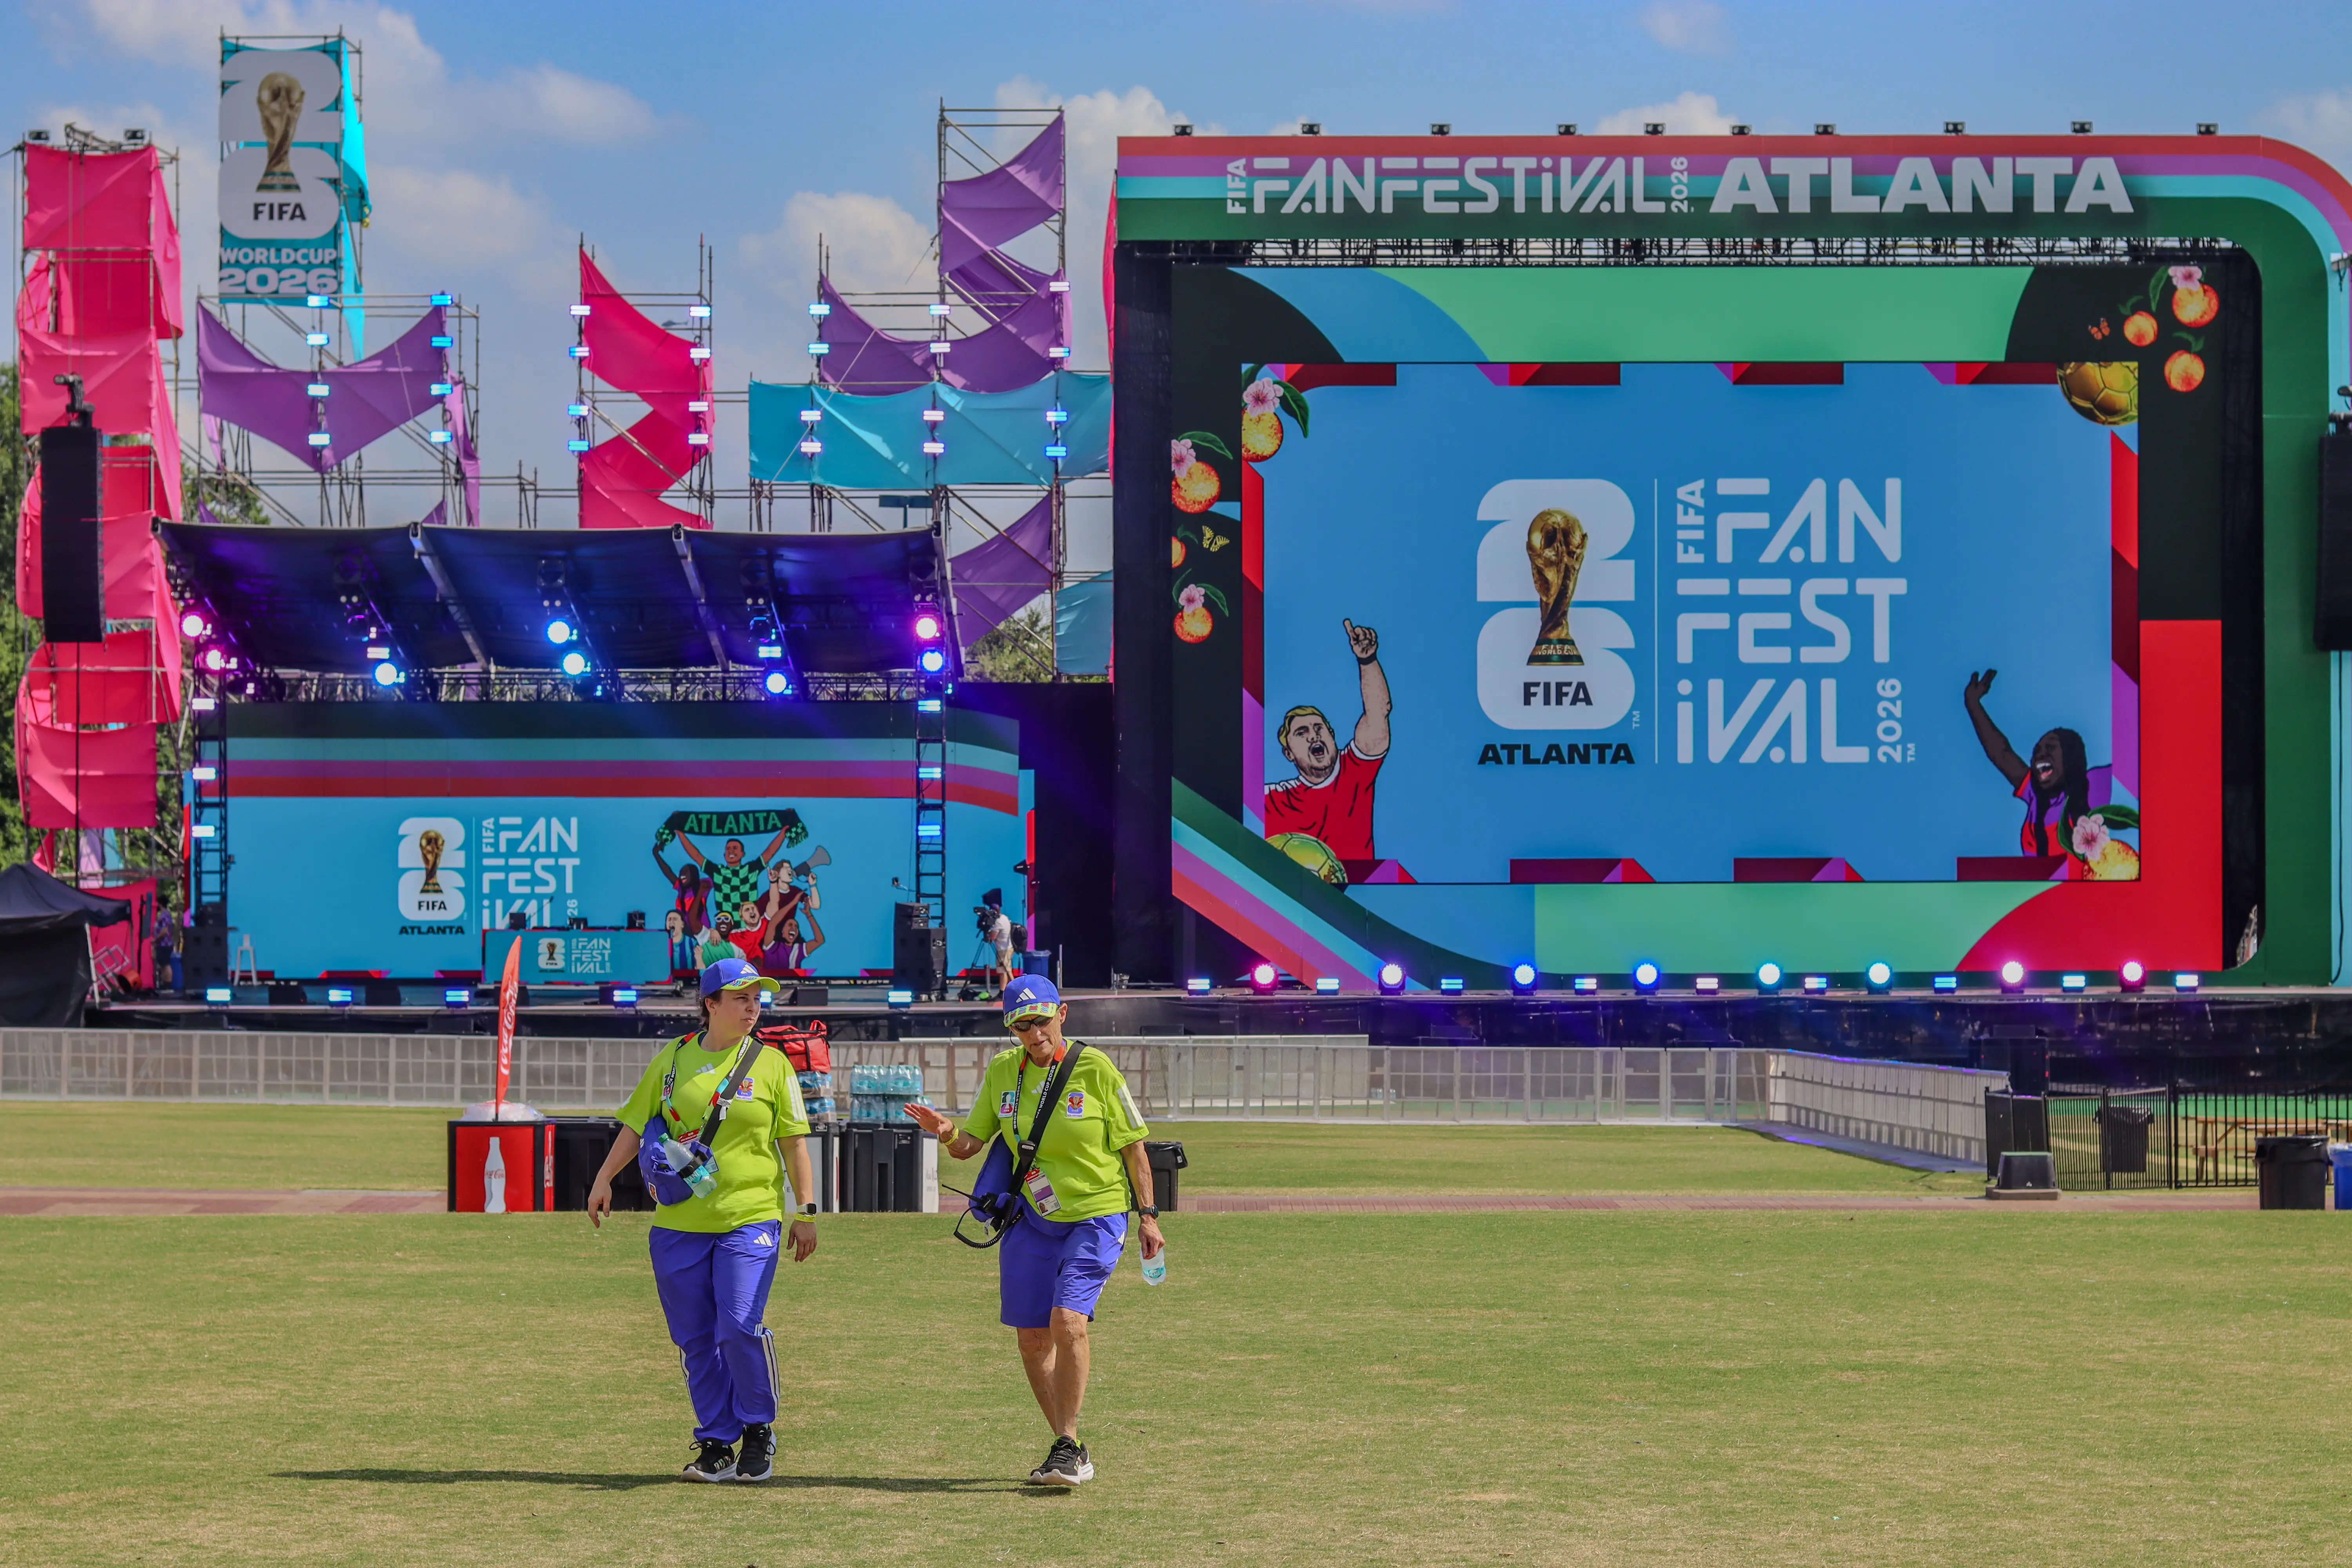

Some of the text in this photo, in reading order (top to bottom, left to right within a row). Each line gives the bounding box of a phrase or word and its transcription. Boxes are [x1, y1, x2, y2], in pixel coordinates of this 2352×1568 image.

[1227, 158, 1247, 214] FIFA
[1670, 157, 1688, 213] 2026
[1709, 157, 2134, 213] ATLANTA
[253, 203, 307, 220] FIFA
[219, 267, 338, 294] 2026
[1677, 479, 1705, 563] FIFA
[1717, 478, 1902, 563] FAN
[1677, 578, 1907, 663] FEST
[1523, 682, 1593, 706] FIFA
[1877, 679, 1902, 763] 2026
[1477, 743, 1635, 765] ATLANTA
[482, 817, 495, 853] FIFA
[499, 817, 578, 853] FAN
[684, 813, 782, 833] ATLANTA
[482, 858, 581, 894] FEST
[417, 900, 447, 911] FIFA
[398, 926, 465, 935] ATLANTA
[578, 938, 610, 949] FAN
[572, 950, 611, 961] FEST
[1048, 1065, 1056, 1082] 2026
